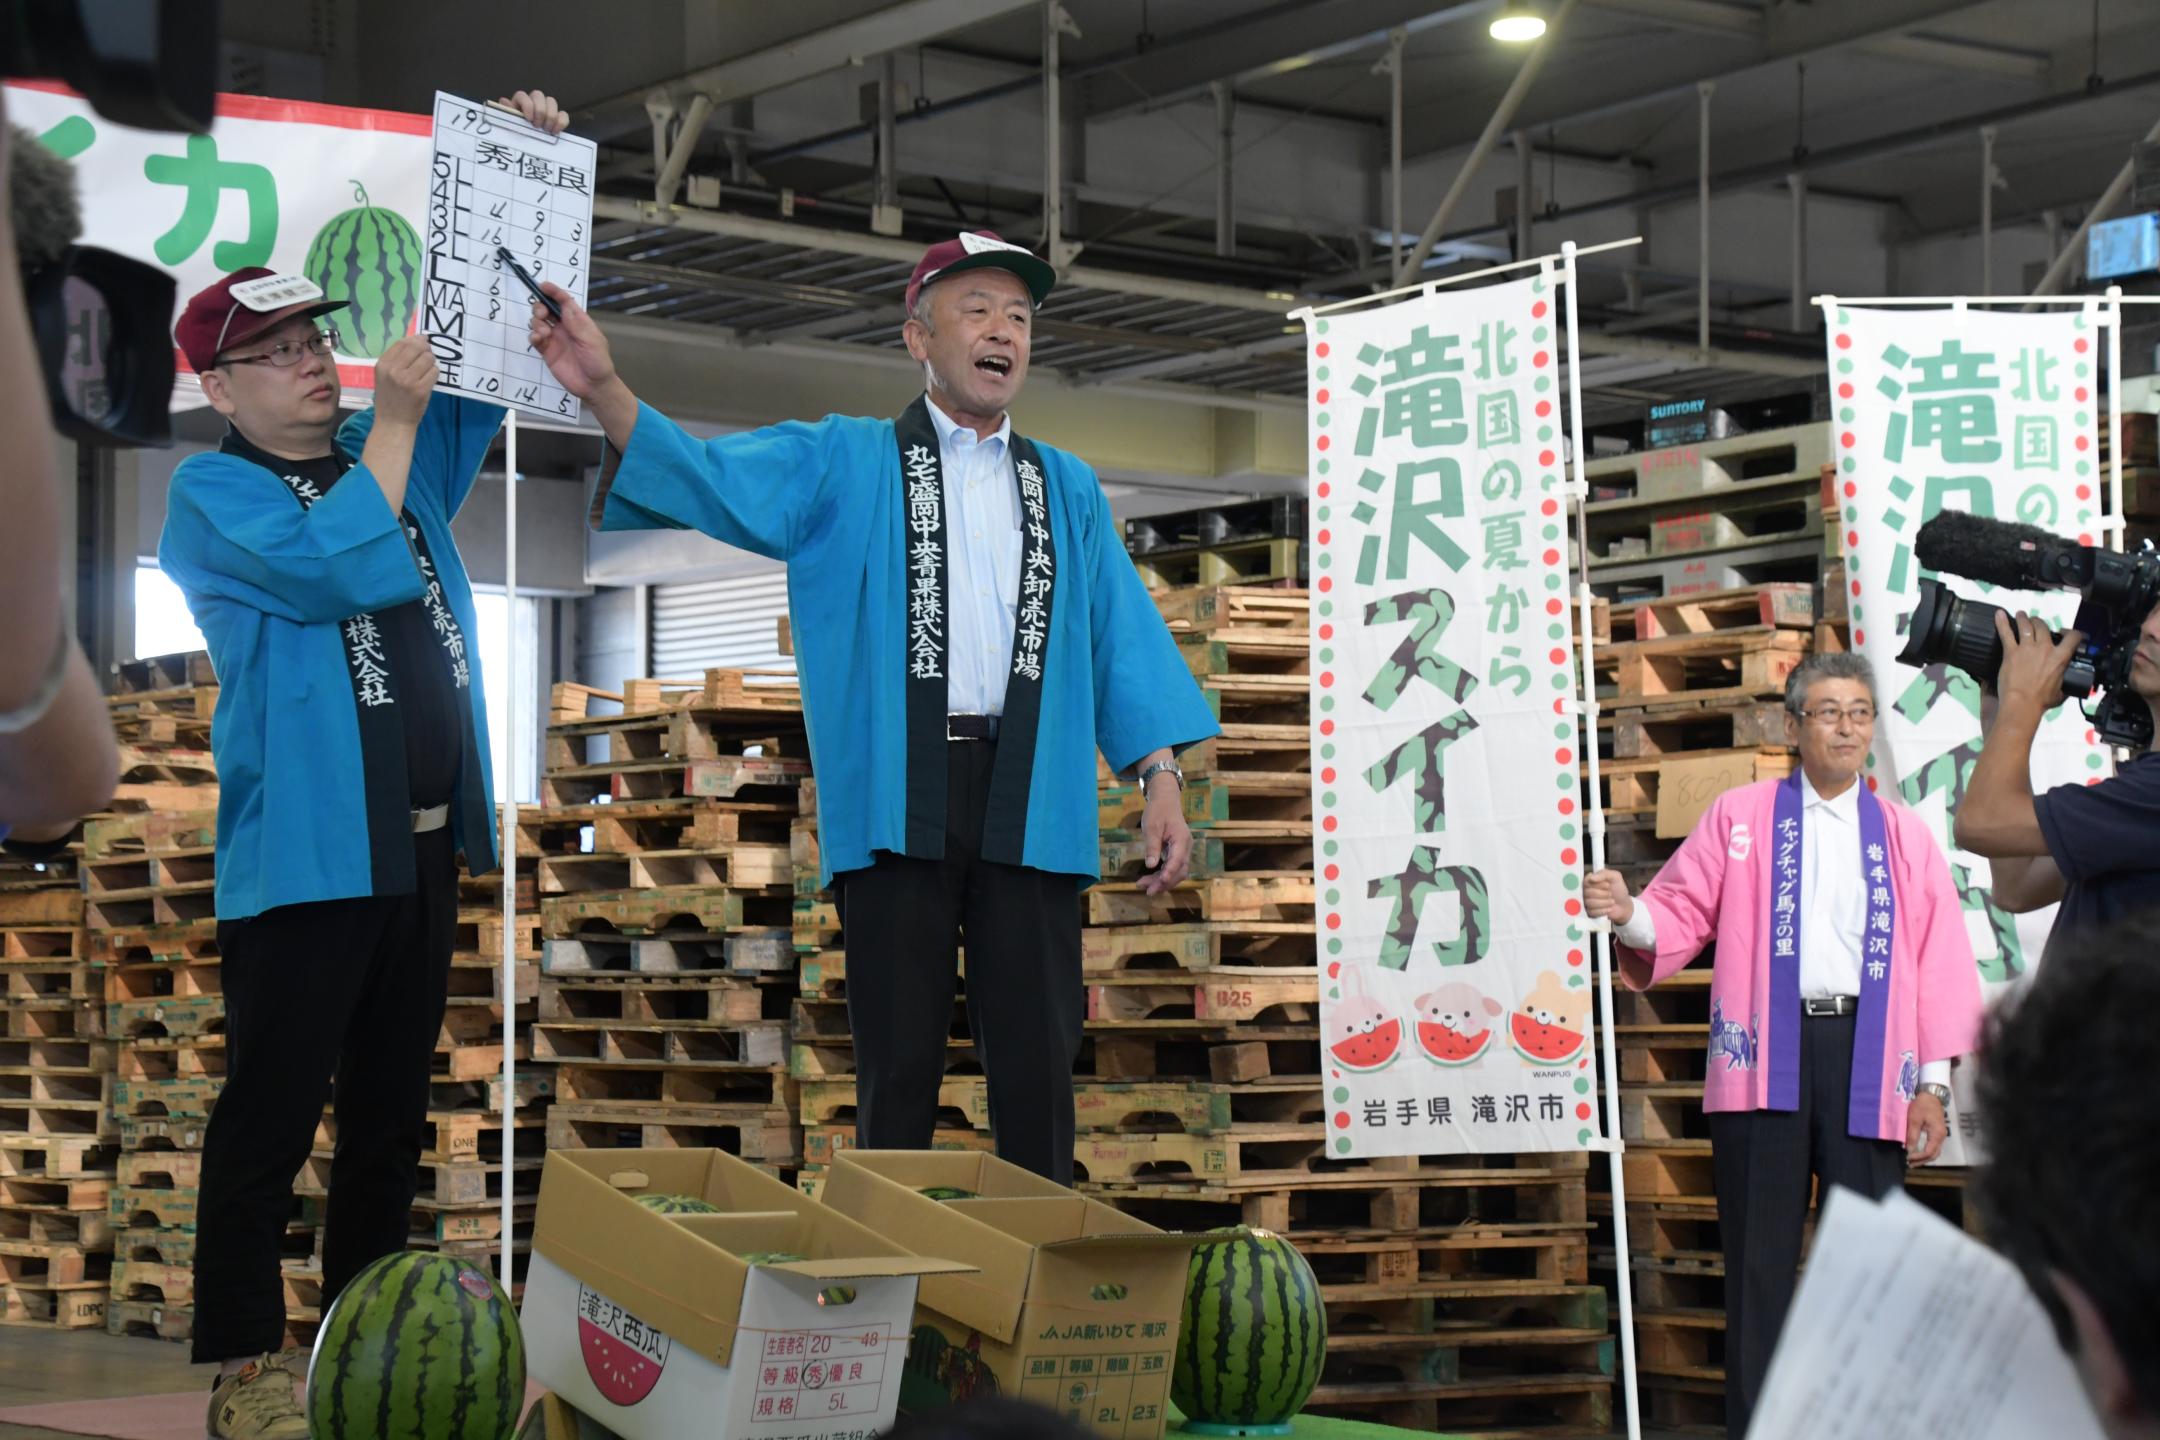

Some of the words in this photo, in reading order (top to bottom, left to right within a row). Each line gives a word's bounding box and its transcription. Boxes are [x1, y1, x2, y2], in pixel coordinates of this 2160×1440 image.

[433, 151, 472, 186] 5L
[432, 179, 471, 213] 4L
[432, 205, 469, 237] 3L
[430, 231, 468, 263] 2L
[430, 254, 466, 288] L
[1472, 319, 1531, 697] 北国の夏から
[1013, 460, 1053, 681] 盛岡市中央卸売市場
[1350, 325, 1490, 971] 滝沢スイカ
[1867, 843, 1892, 981] 岩手県滝沢市
[1362, 1096, 1453, 1127] 岩手県
[1471, 1092, 1564, 1123] 滝沢市
[578, 1292, 662, 1361] 滝沢西瓜
